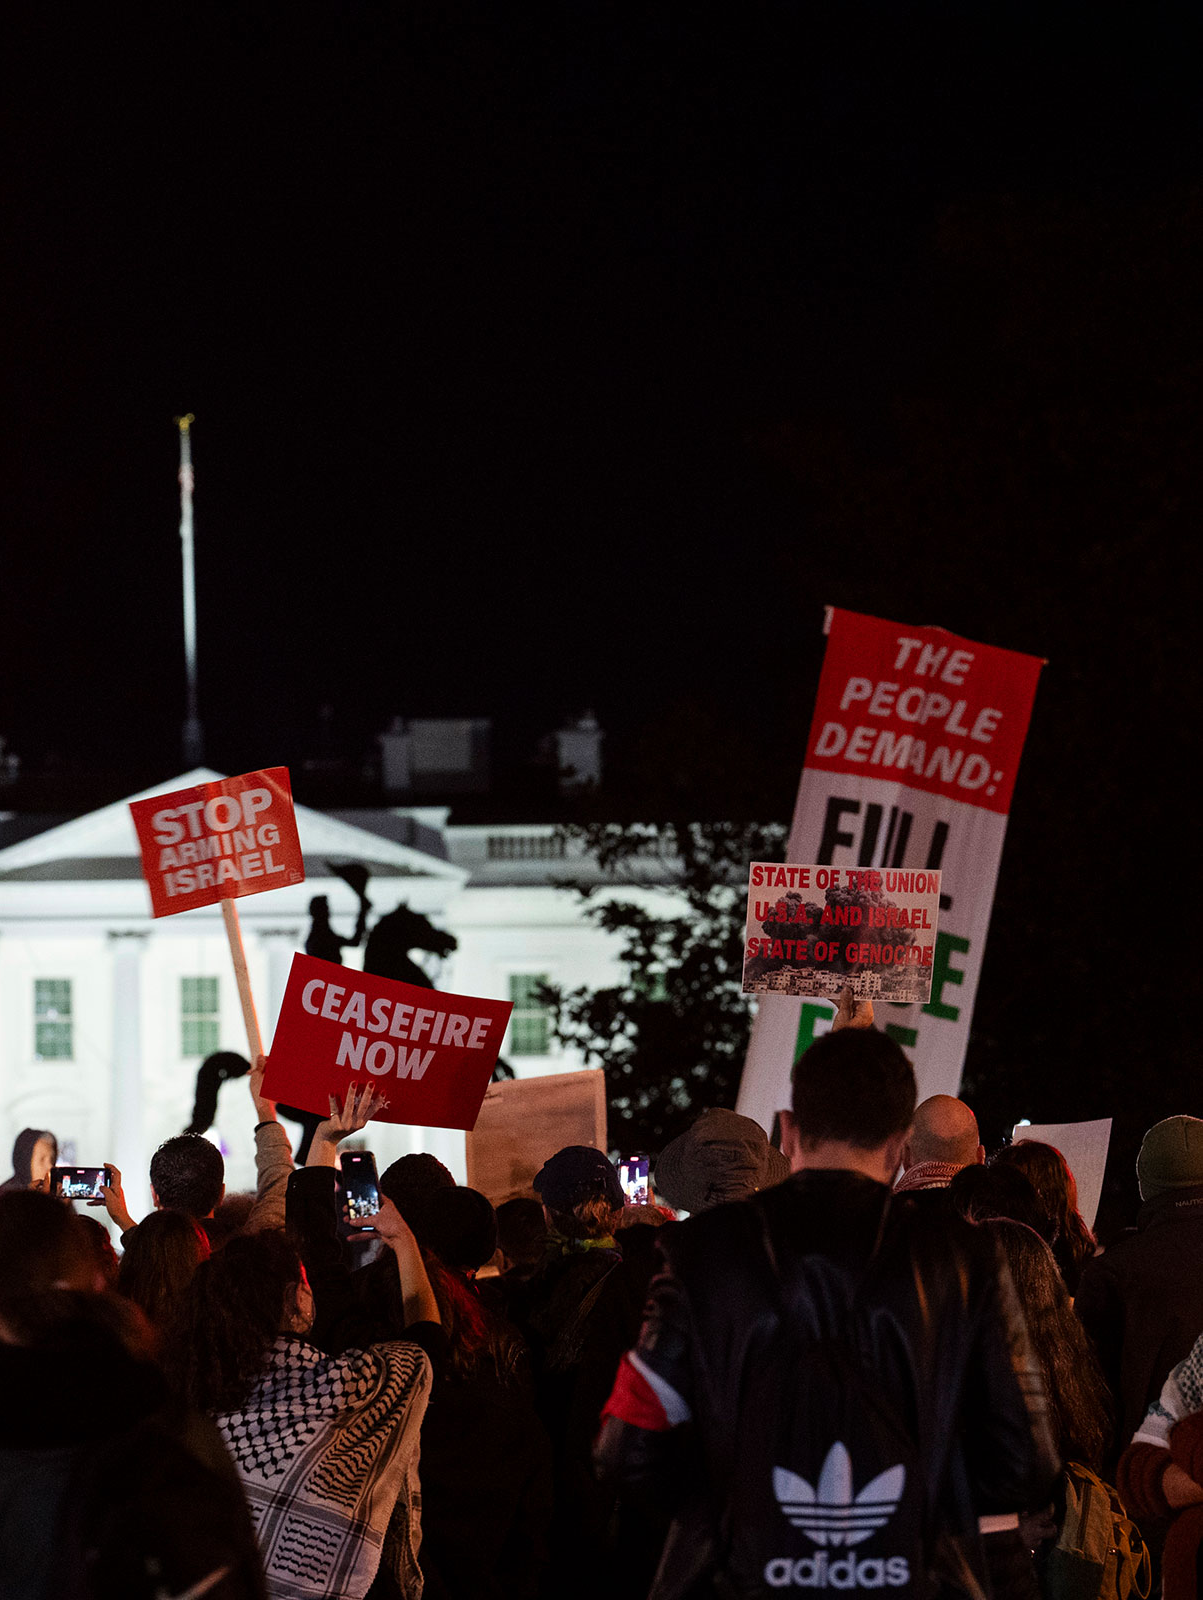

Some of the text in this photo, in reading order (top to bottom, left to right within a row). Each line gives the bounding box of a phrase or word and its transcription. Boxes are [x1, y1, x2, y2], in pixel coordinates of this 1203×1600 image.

[894, 637, 975, 686] THE
[840, 677, 1003, 744] PEOPLE
[814, 721, 1004, 796] DEMAND:
[151, 788, 272, 845] STOP
[159, 823, 280, 871] ARMING
[163, 850, 285, 897] ISRAEL
[751, 866, 939, 894] STATE OF THE UNION
[755, 901, 932, 929] U.S.A. AND ISRAEL
[748, 937, 933, 966] STATE OF GENOCIDE
[302, 979, 492, 1049] CEASEFIRE
[335, 1031, 436, 1080] NOW
[764, 1550, 911, 1589] adidas
